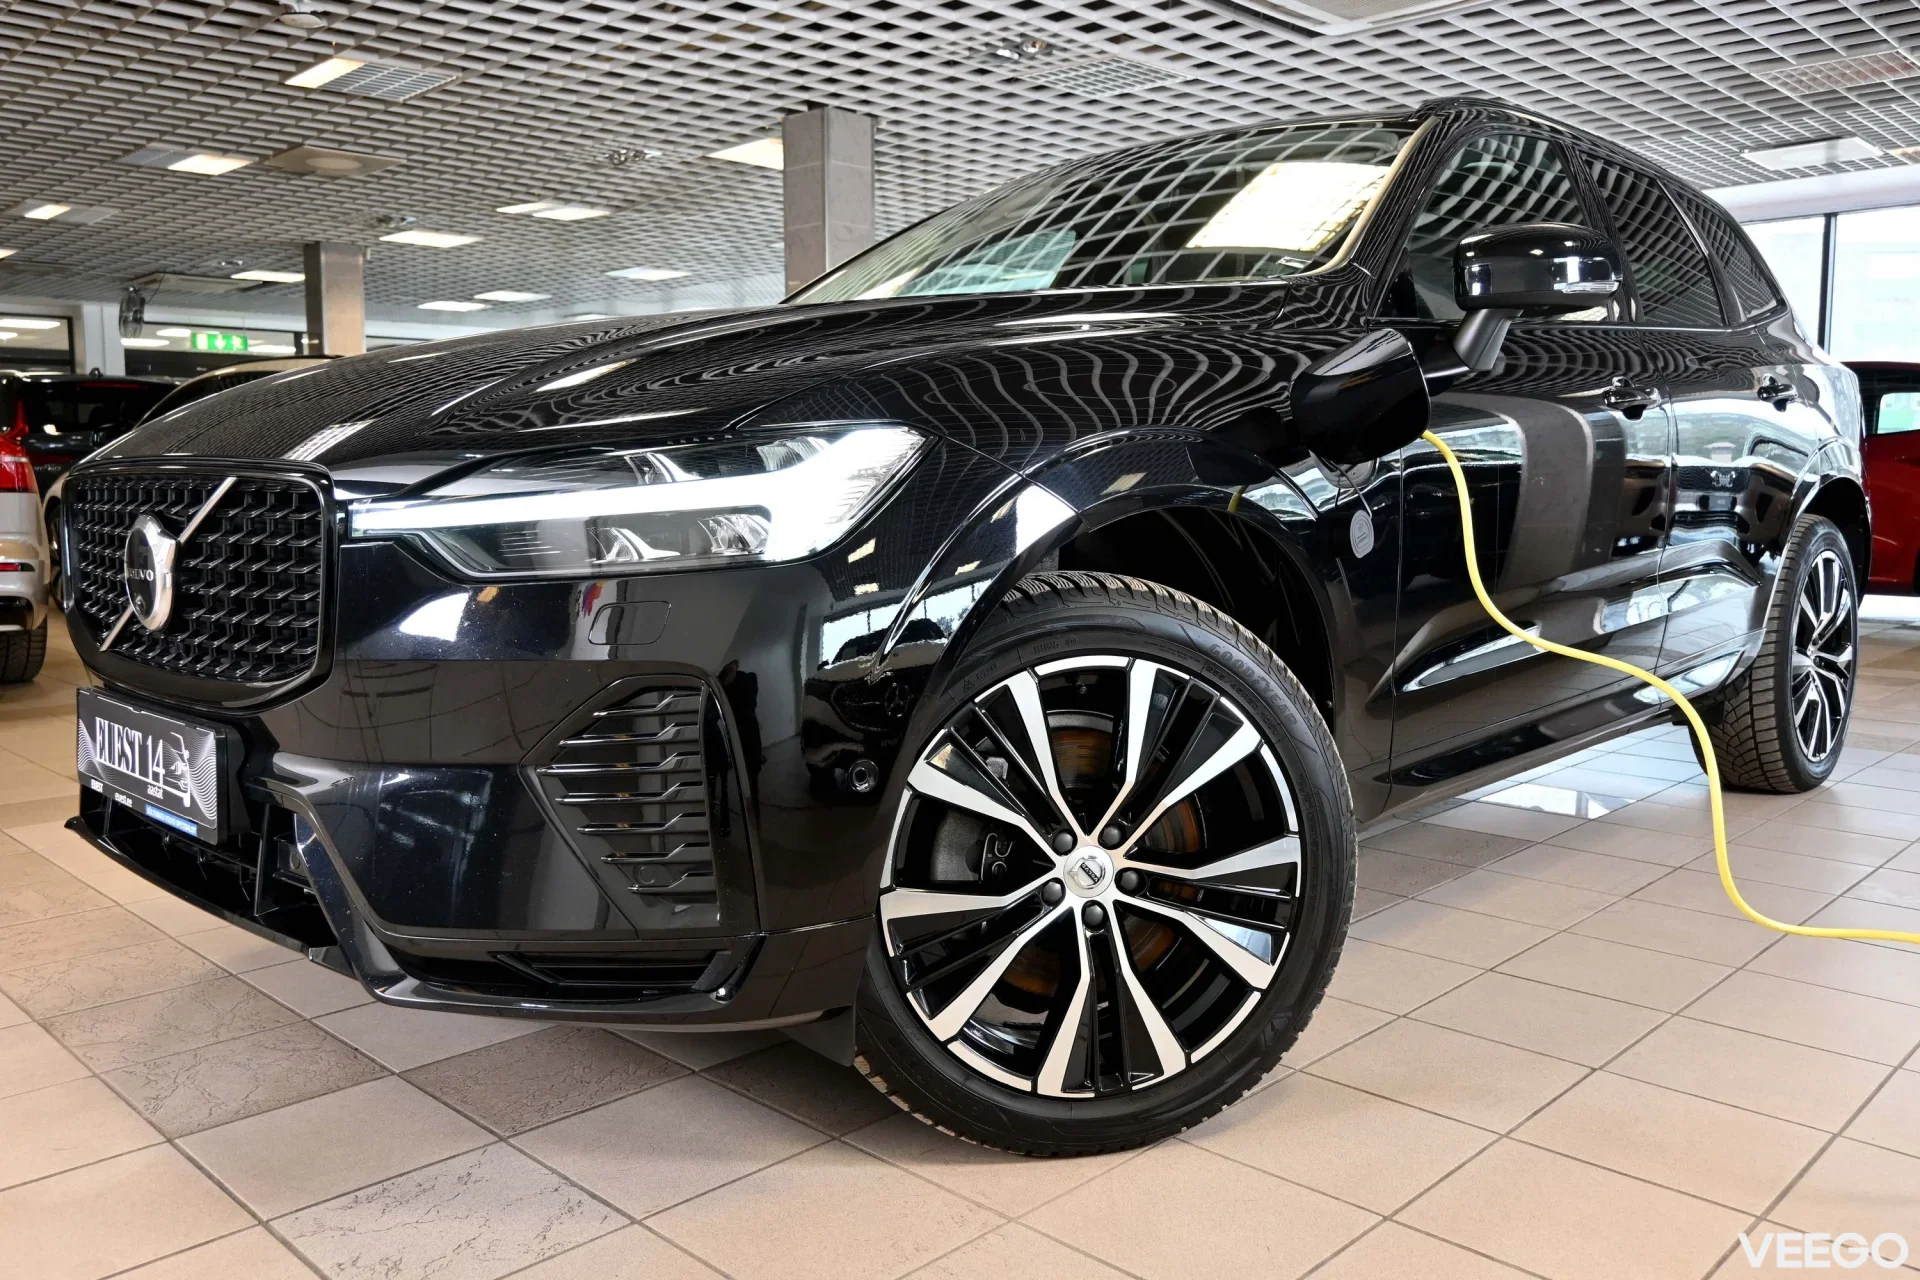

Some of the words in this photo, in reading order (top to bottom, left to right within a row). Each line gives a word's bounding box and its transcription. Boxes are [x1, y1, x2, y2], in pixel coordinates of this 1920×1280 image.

[95, 716, 142, 776] EUEST
[147, 734, 165, 786] 14
[1081, 862, 1099, 883] VOLVO
